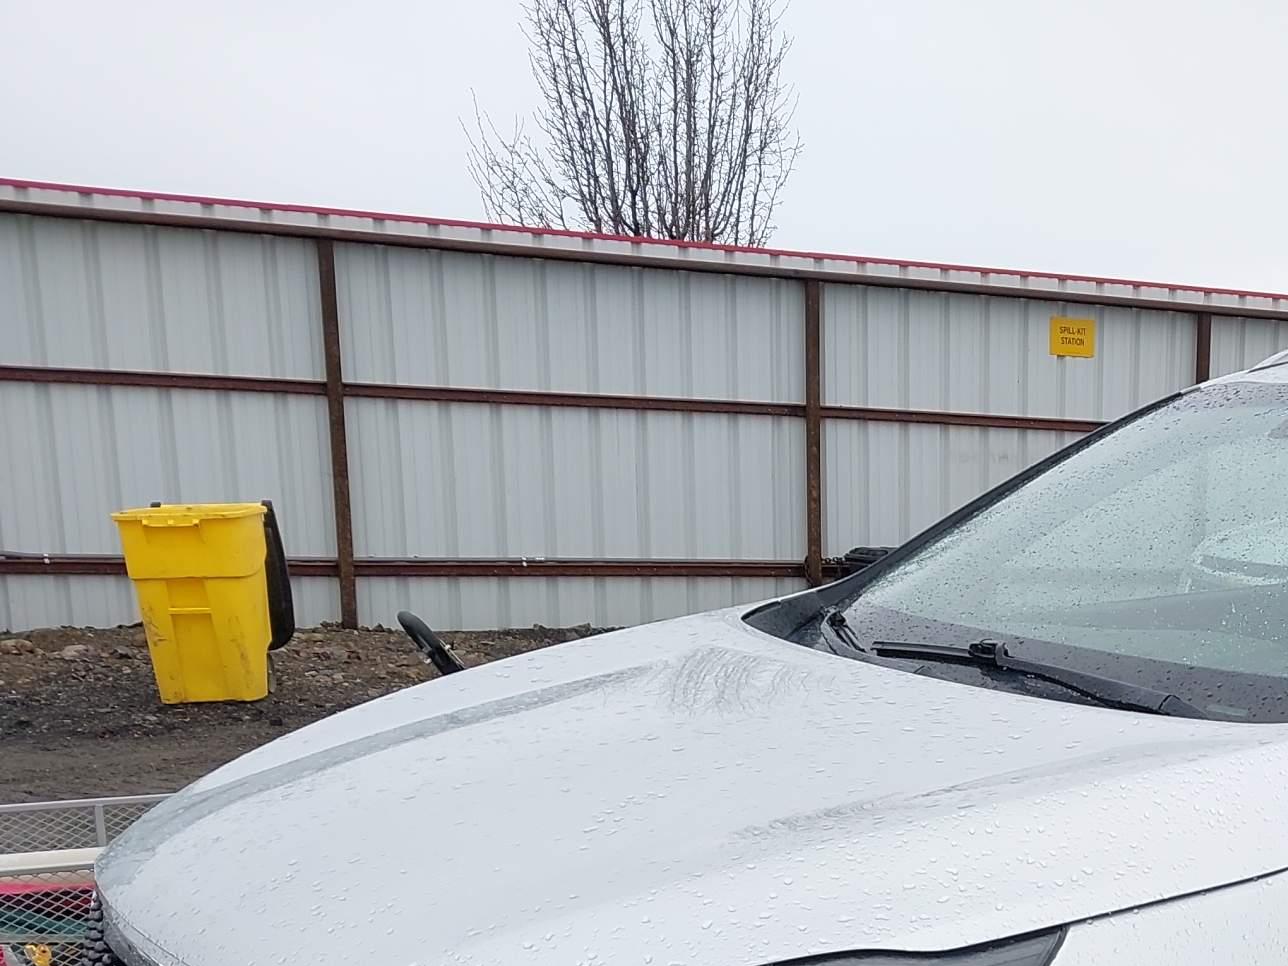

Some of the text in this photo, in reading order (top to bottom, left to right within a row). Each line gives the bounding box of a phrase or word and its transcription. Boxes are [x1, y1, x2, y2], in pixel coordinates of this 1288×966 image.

[1059, 327, 1086, 336] SPILL KIT
[1061, 337, 1085, 346] STATION
